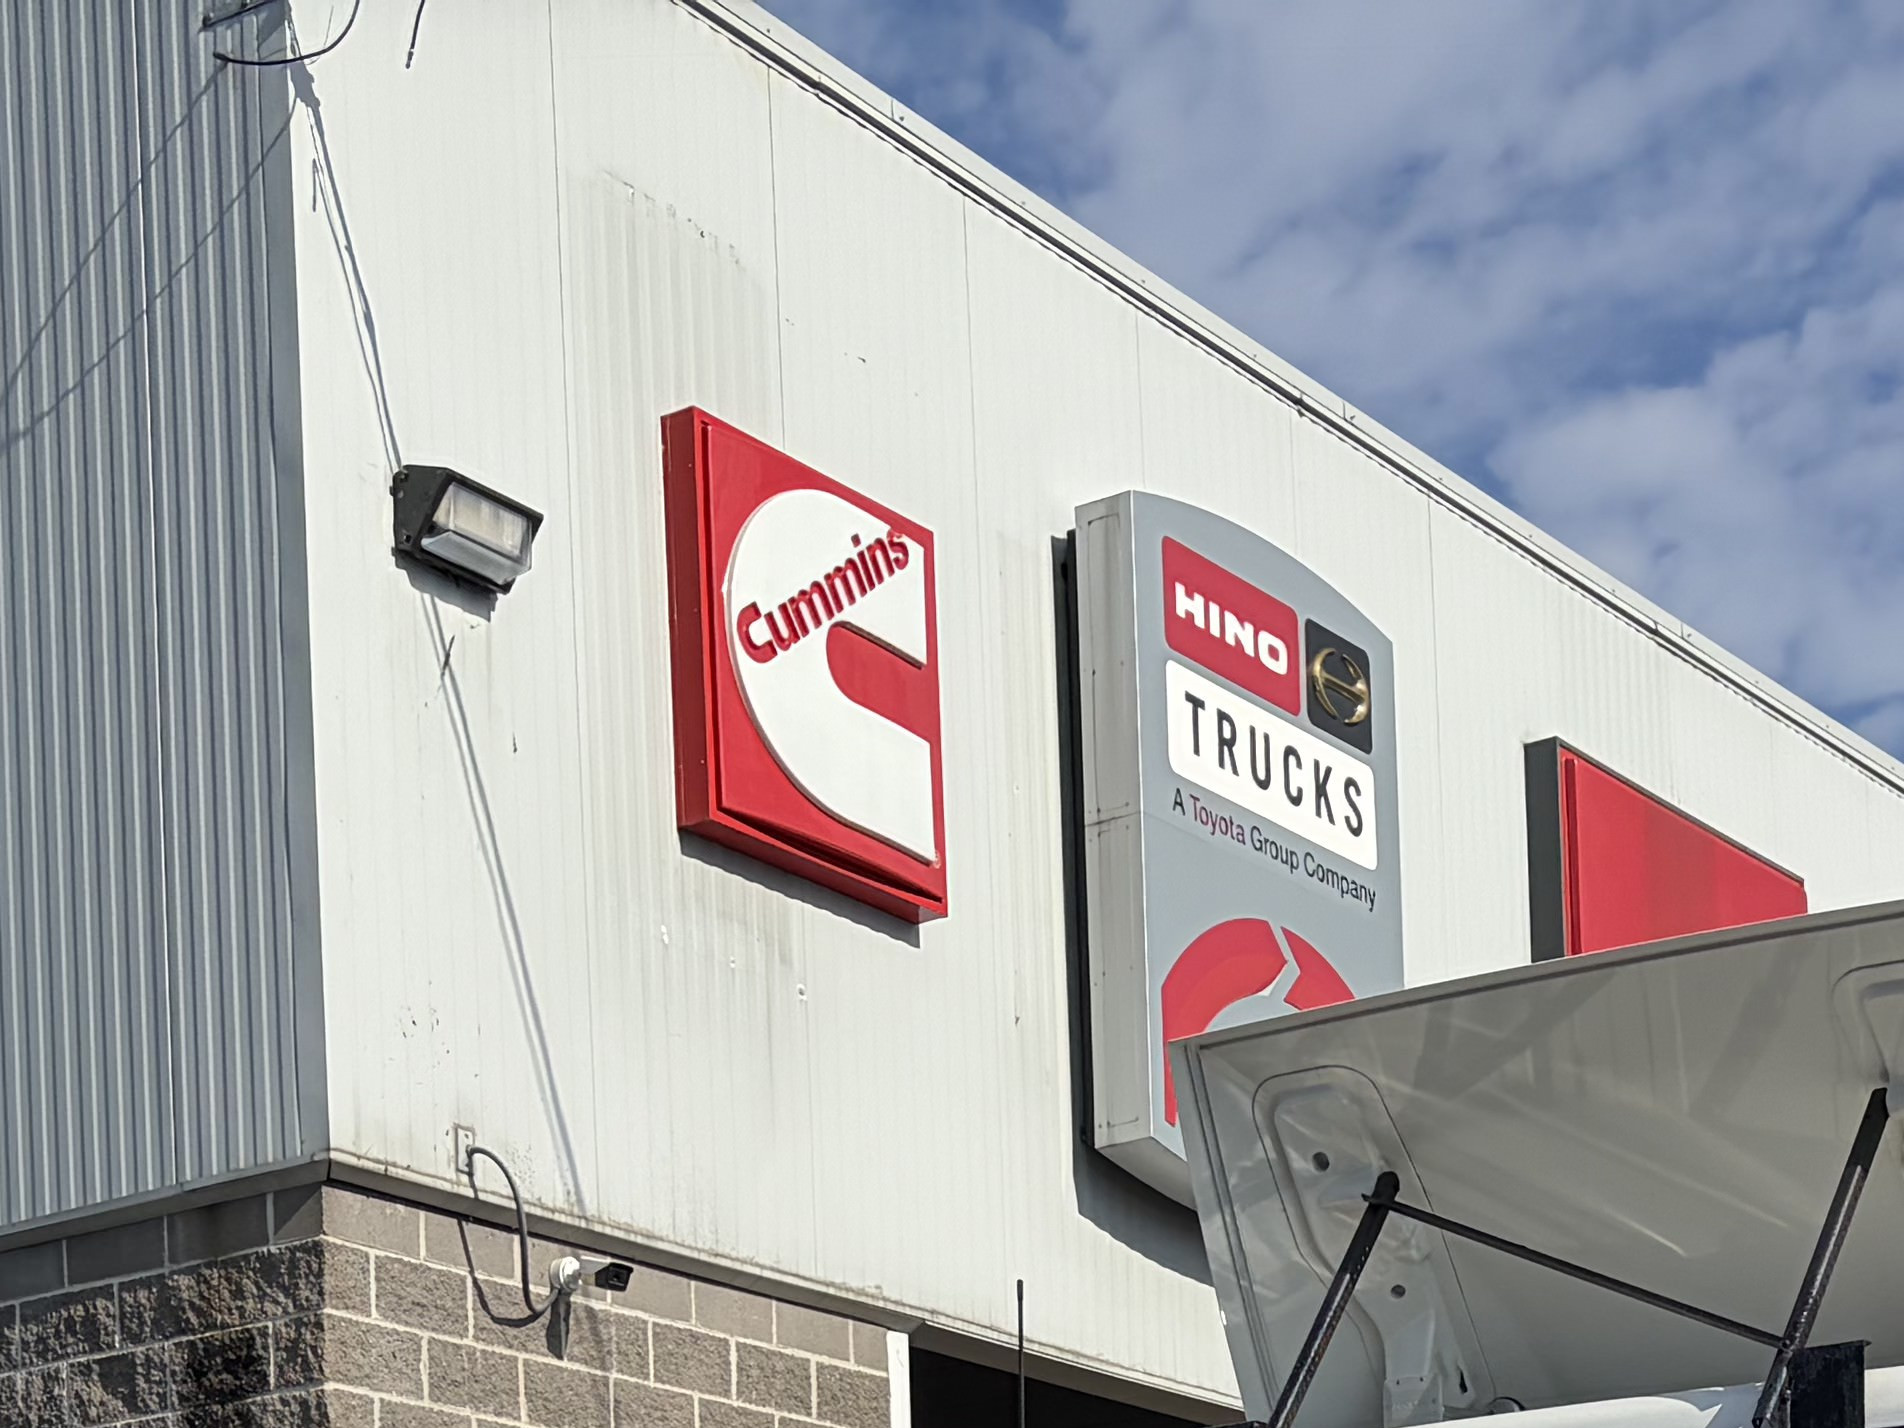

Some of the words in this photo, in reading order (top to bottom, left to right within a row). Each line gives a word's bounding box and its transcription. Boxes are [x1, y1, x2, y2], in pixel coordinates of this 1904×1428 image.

[736, 528, 909, 664] Cummins
[1174, 580, 1289, 675] HINO
[1184, 690, 1364, 838] TRUCKS
[1172, 787, 1186, 816] A
[1189, 793, 1247, 846] Toyota
[1250, 825, 1300, 875] Group
[1303, 852, 1377, 912] Company
